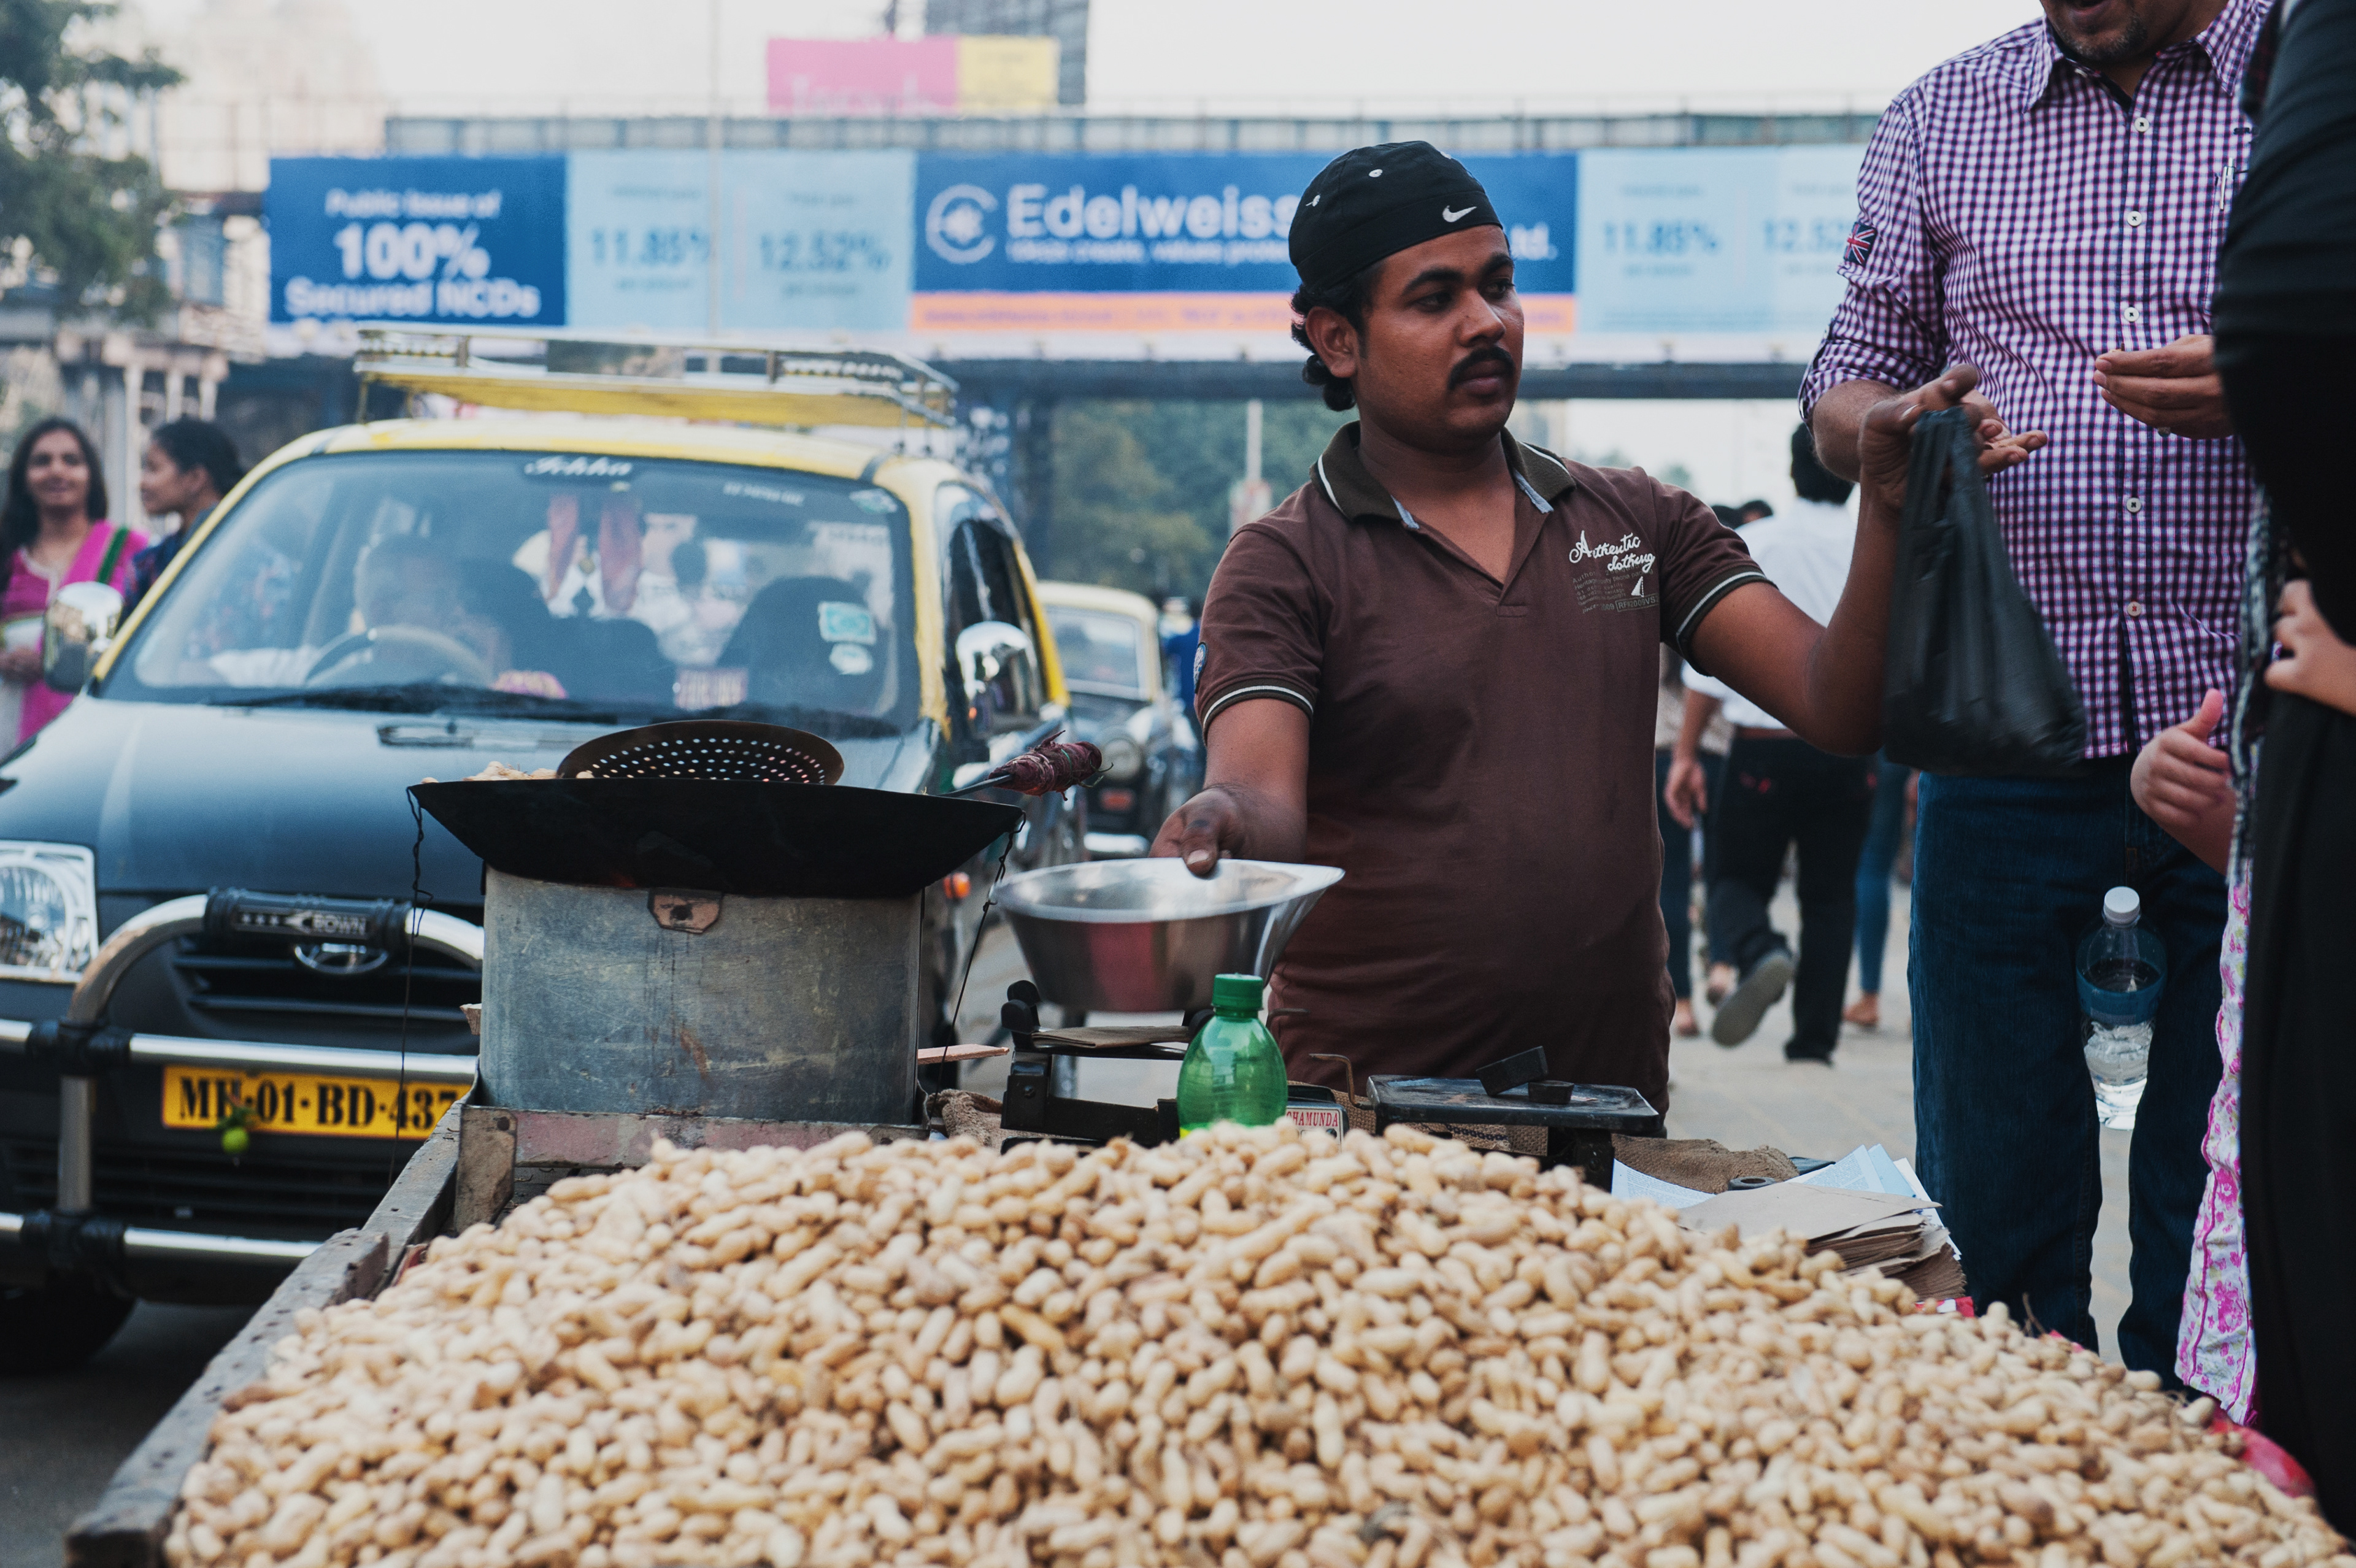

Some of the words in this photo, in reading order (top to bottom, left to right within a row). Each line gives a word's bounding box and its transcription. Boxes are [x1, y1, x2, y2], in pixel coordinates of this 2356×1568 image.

[1007, 183, 1301, 239] Edelweiss
[334, 221, 490, 280] 100%
[285, 276, 434, 317] Secured
[436, 277, 541, 318] NCDs
[1569, 529, 1641, 563] Authentic
[1607, 553, 1655, 573] clothing
